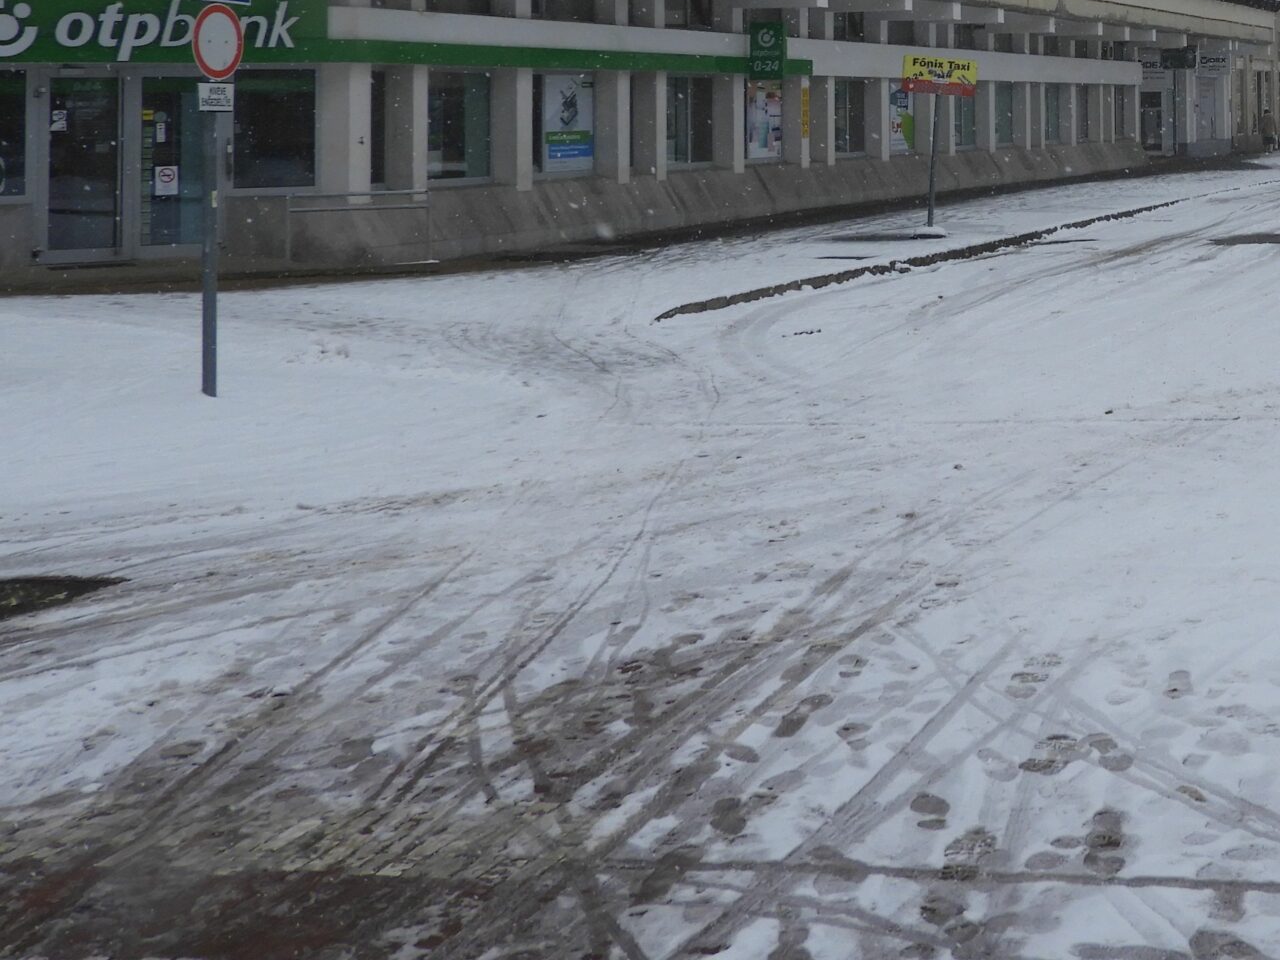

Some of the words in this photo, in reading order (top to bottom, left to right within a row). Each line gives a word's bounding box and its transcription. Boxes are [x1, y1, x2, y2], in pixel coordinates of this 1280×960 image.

[55, 0, 299, 61] otpbnk
[753, 60, 780, 72] 0-24
[947, 60, 971, 72] Taxi
